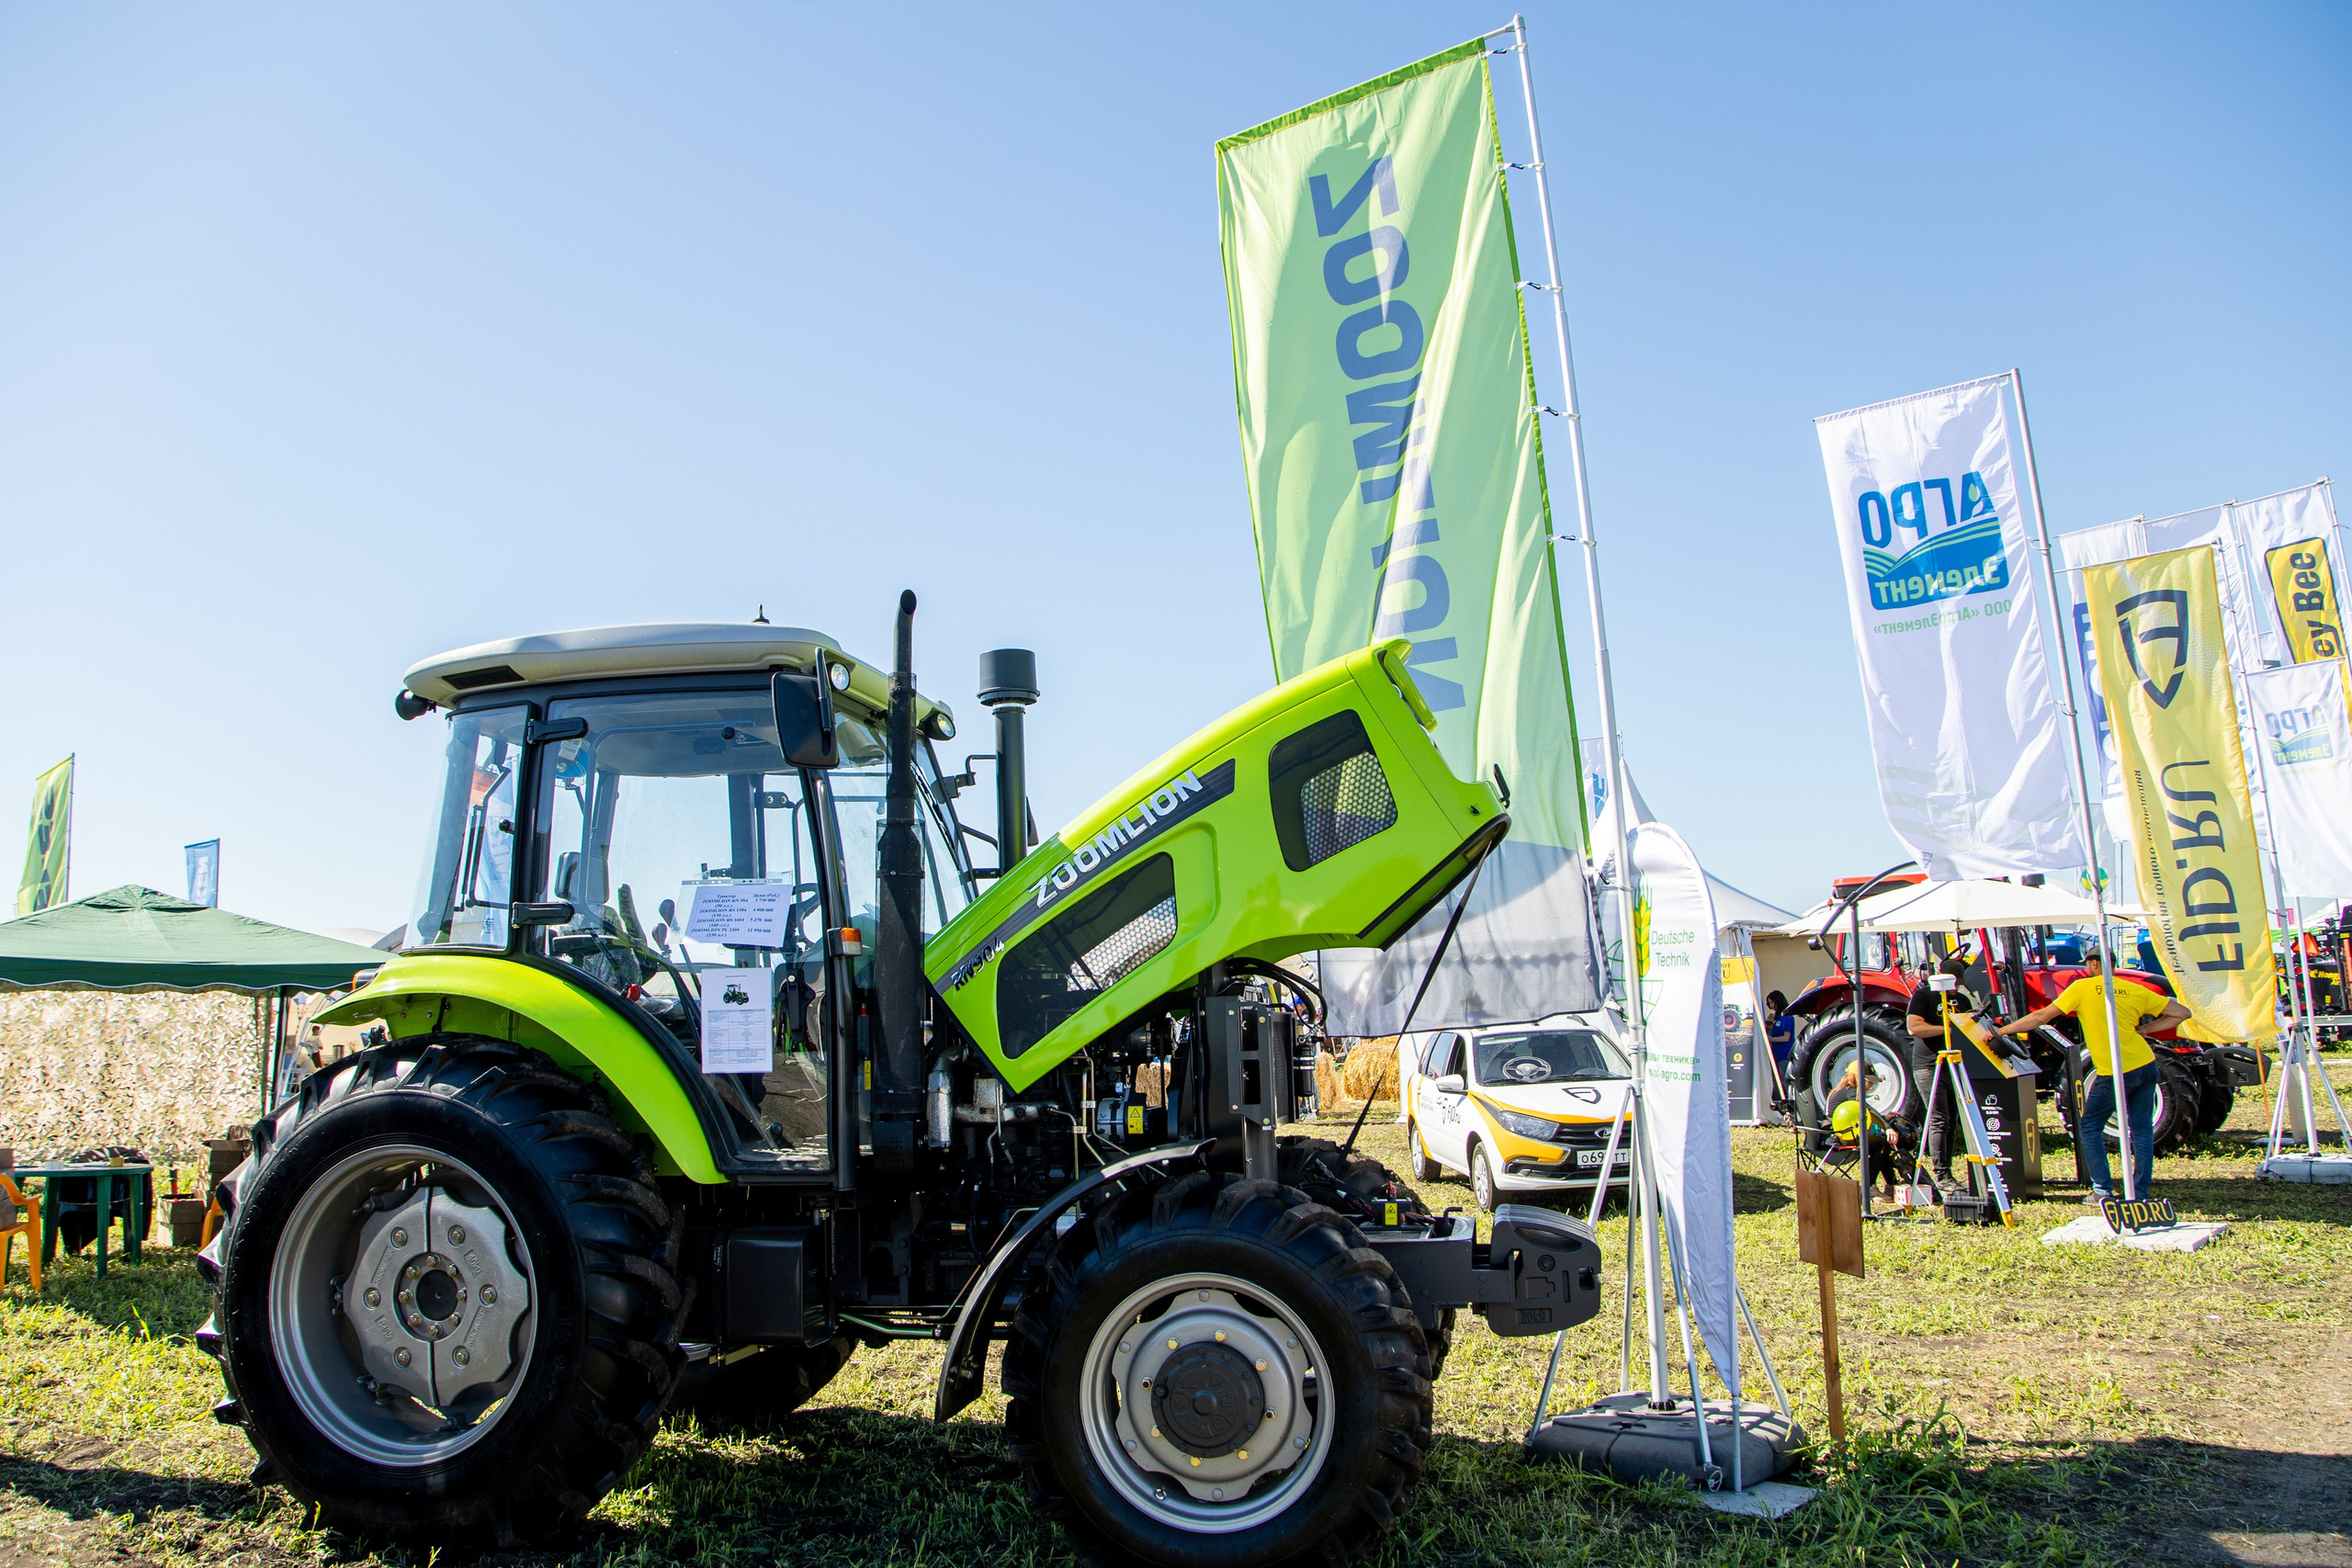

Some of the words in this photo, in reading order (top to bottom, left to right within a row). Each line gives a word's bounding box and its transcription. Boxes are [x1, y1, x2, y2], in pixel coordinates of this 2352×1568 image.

[2290, 551, 2325, 613] Bee
[2307, 620, 2337, 658] ey
[1027, 769, 1204, 908] ZOOMLION
[1651, 929, 1694, 945] Deutsche
[950, 935, 1006, 992] RN904
[1656, 952, 1690, 967] Technik
[1662, 1055, 1701, 1066] техника»
[2120, 1201, 2175, 1228] FJD.RU
